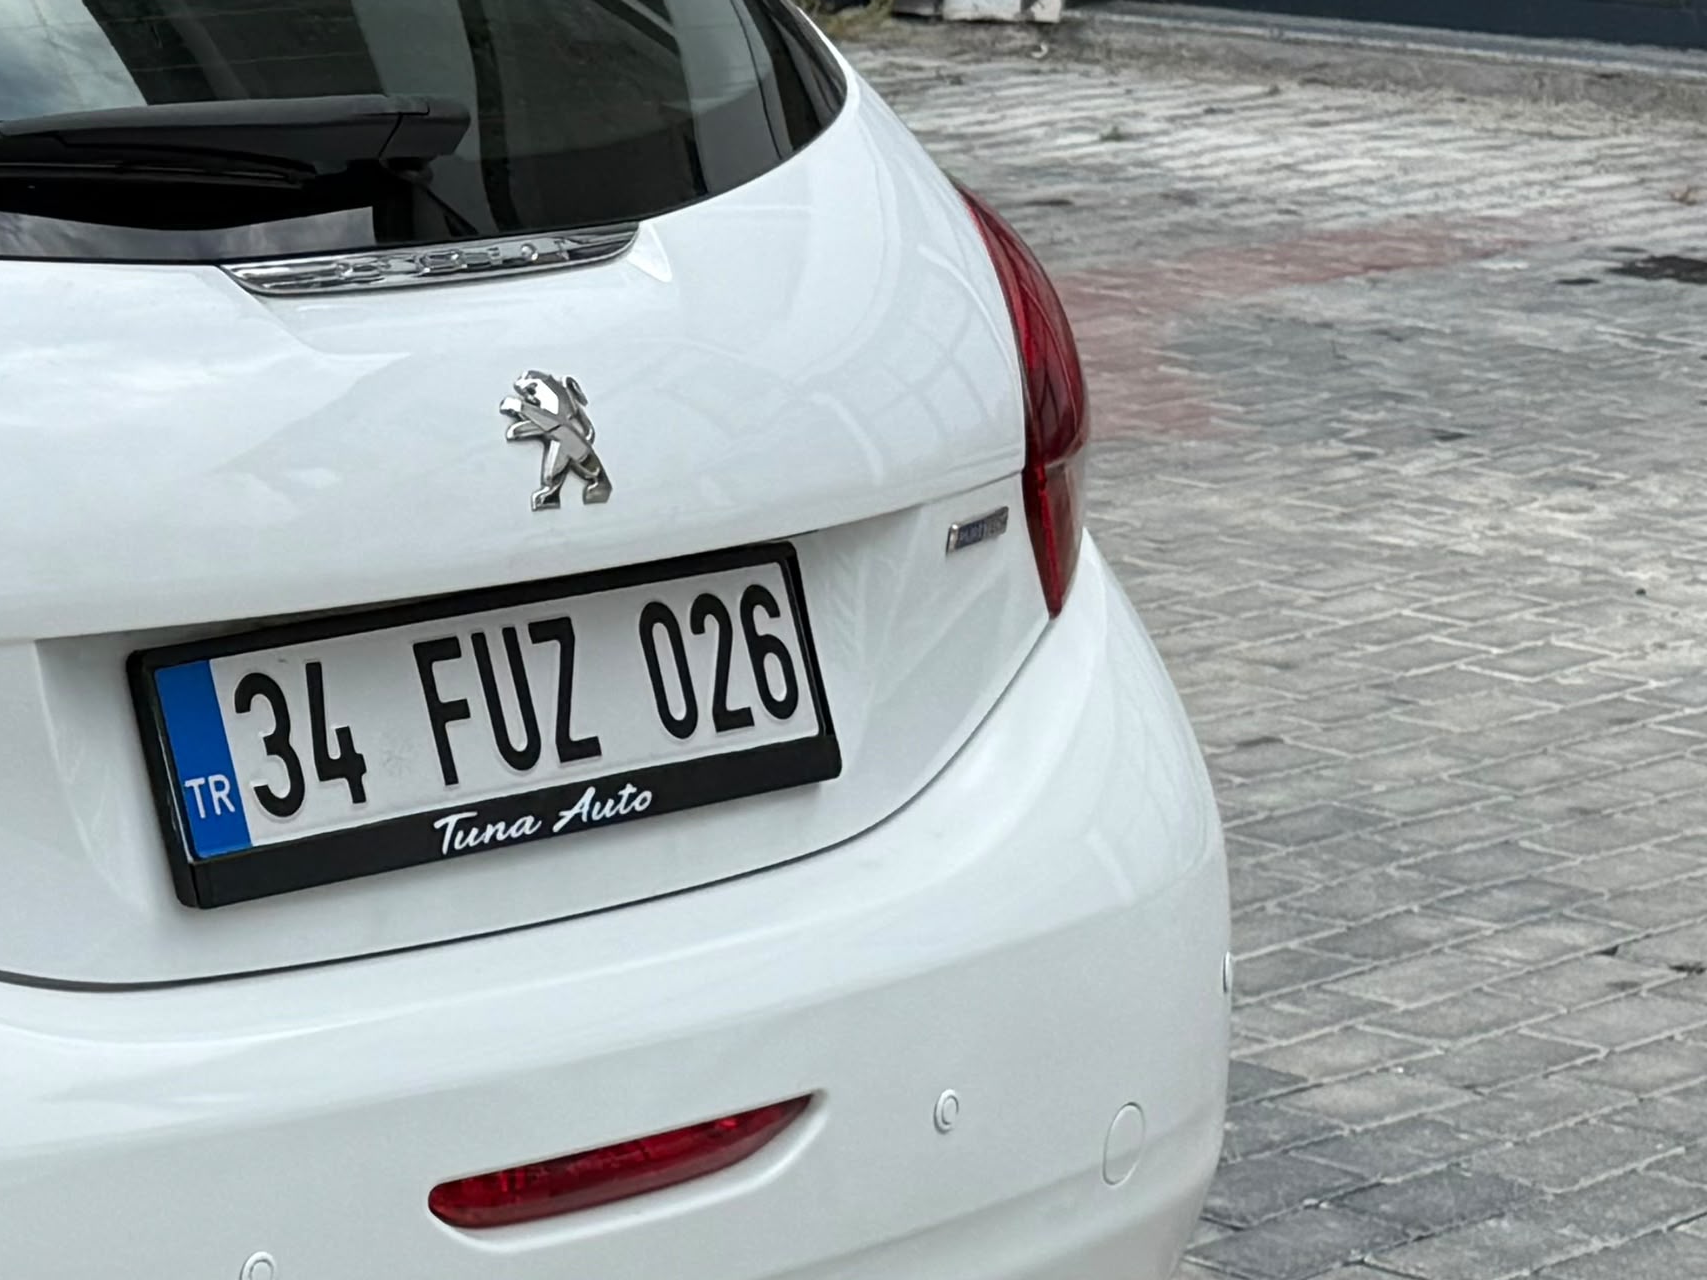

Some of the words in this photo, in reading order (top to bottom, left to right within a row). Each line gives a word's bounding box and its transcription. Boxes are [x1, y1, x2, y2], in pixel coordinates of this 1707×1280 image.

[233, 661, 368, 819] 34
[412, 616, 603, 787] FUZ
[638, 583, 799, 740] 026
[185, 774, 236, 820] TR
[433, 813, 543, 856] Tuna
[552, 782, 654, 835] Auto
